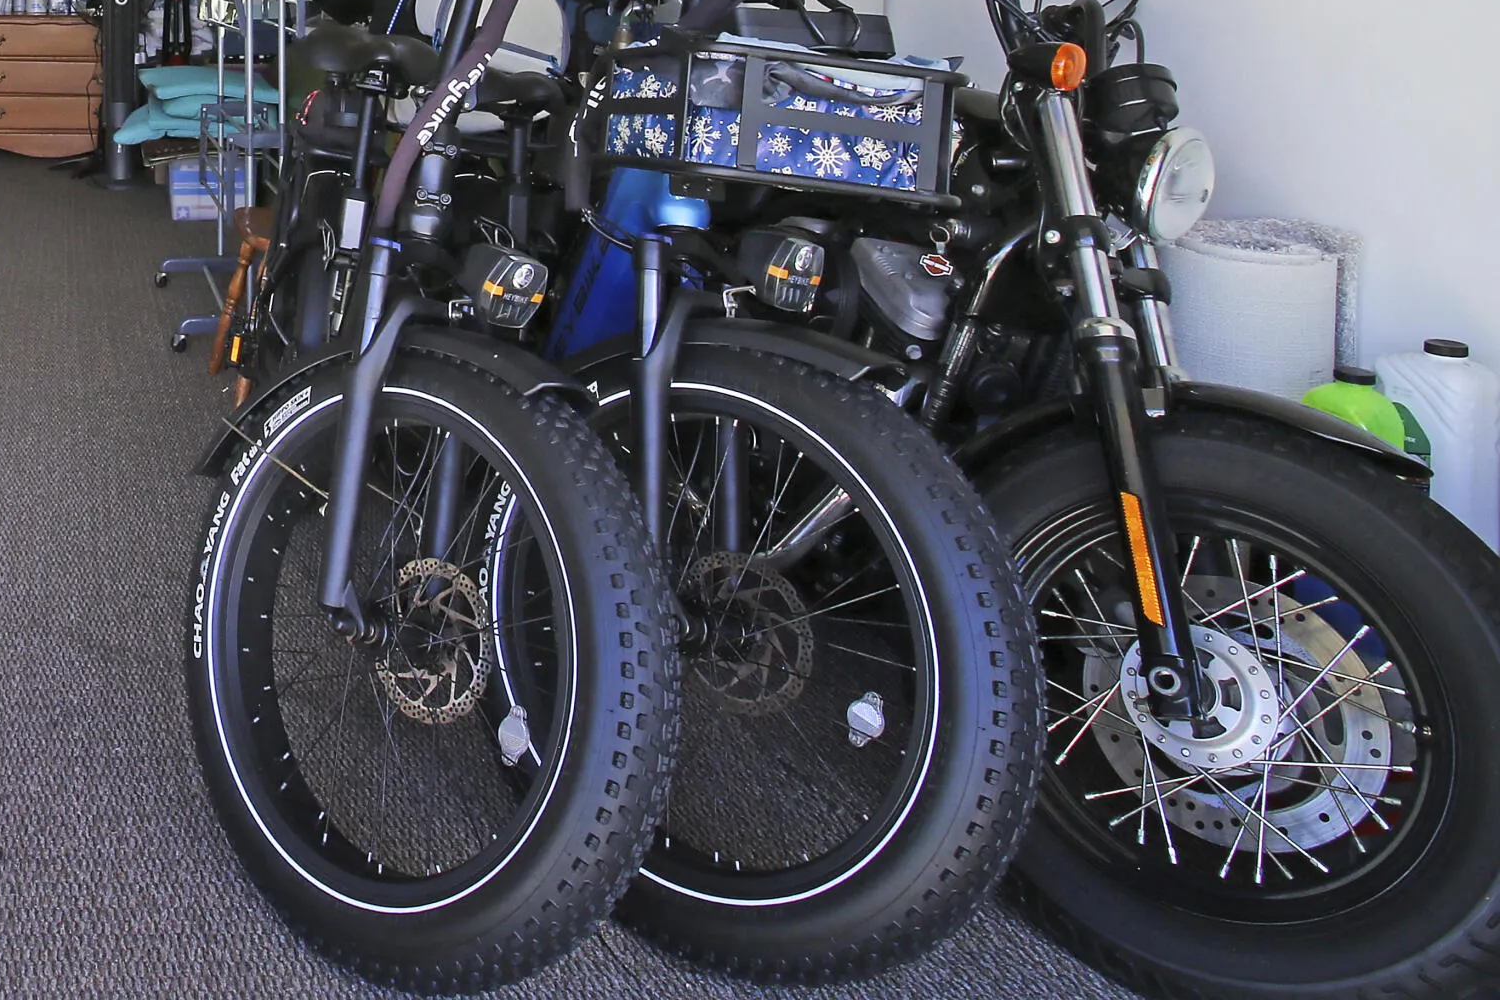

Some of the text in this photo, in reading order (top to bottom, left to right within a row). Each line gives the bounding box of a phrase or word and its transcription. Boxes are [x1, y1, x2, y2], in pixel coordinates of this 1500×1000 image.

[230, 452, 250, 486] Fat
[193, 491, 230, 659] CHAO YANG
